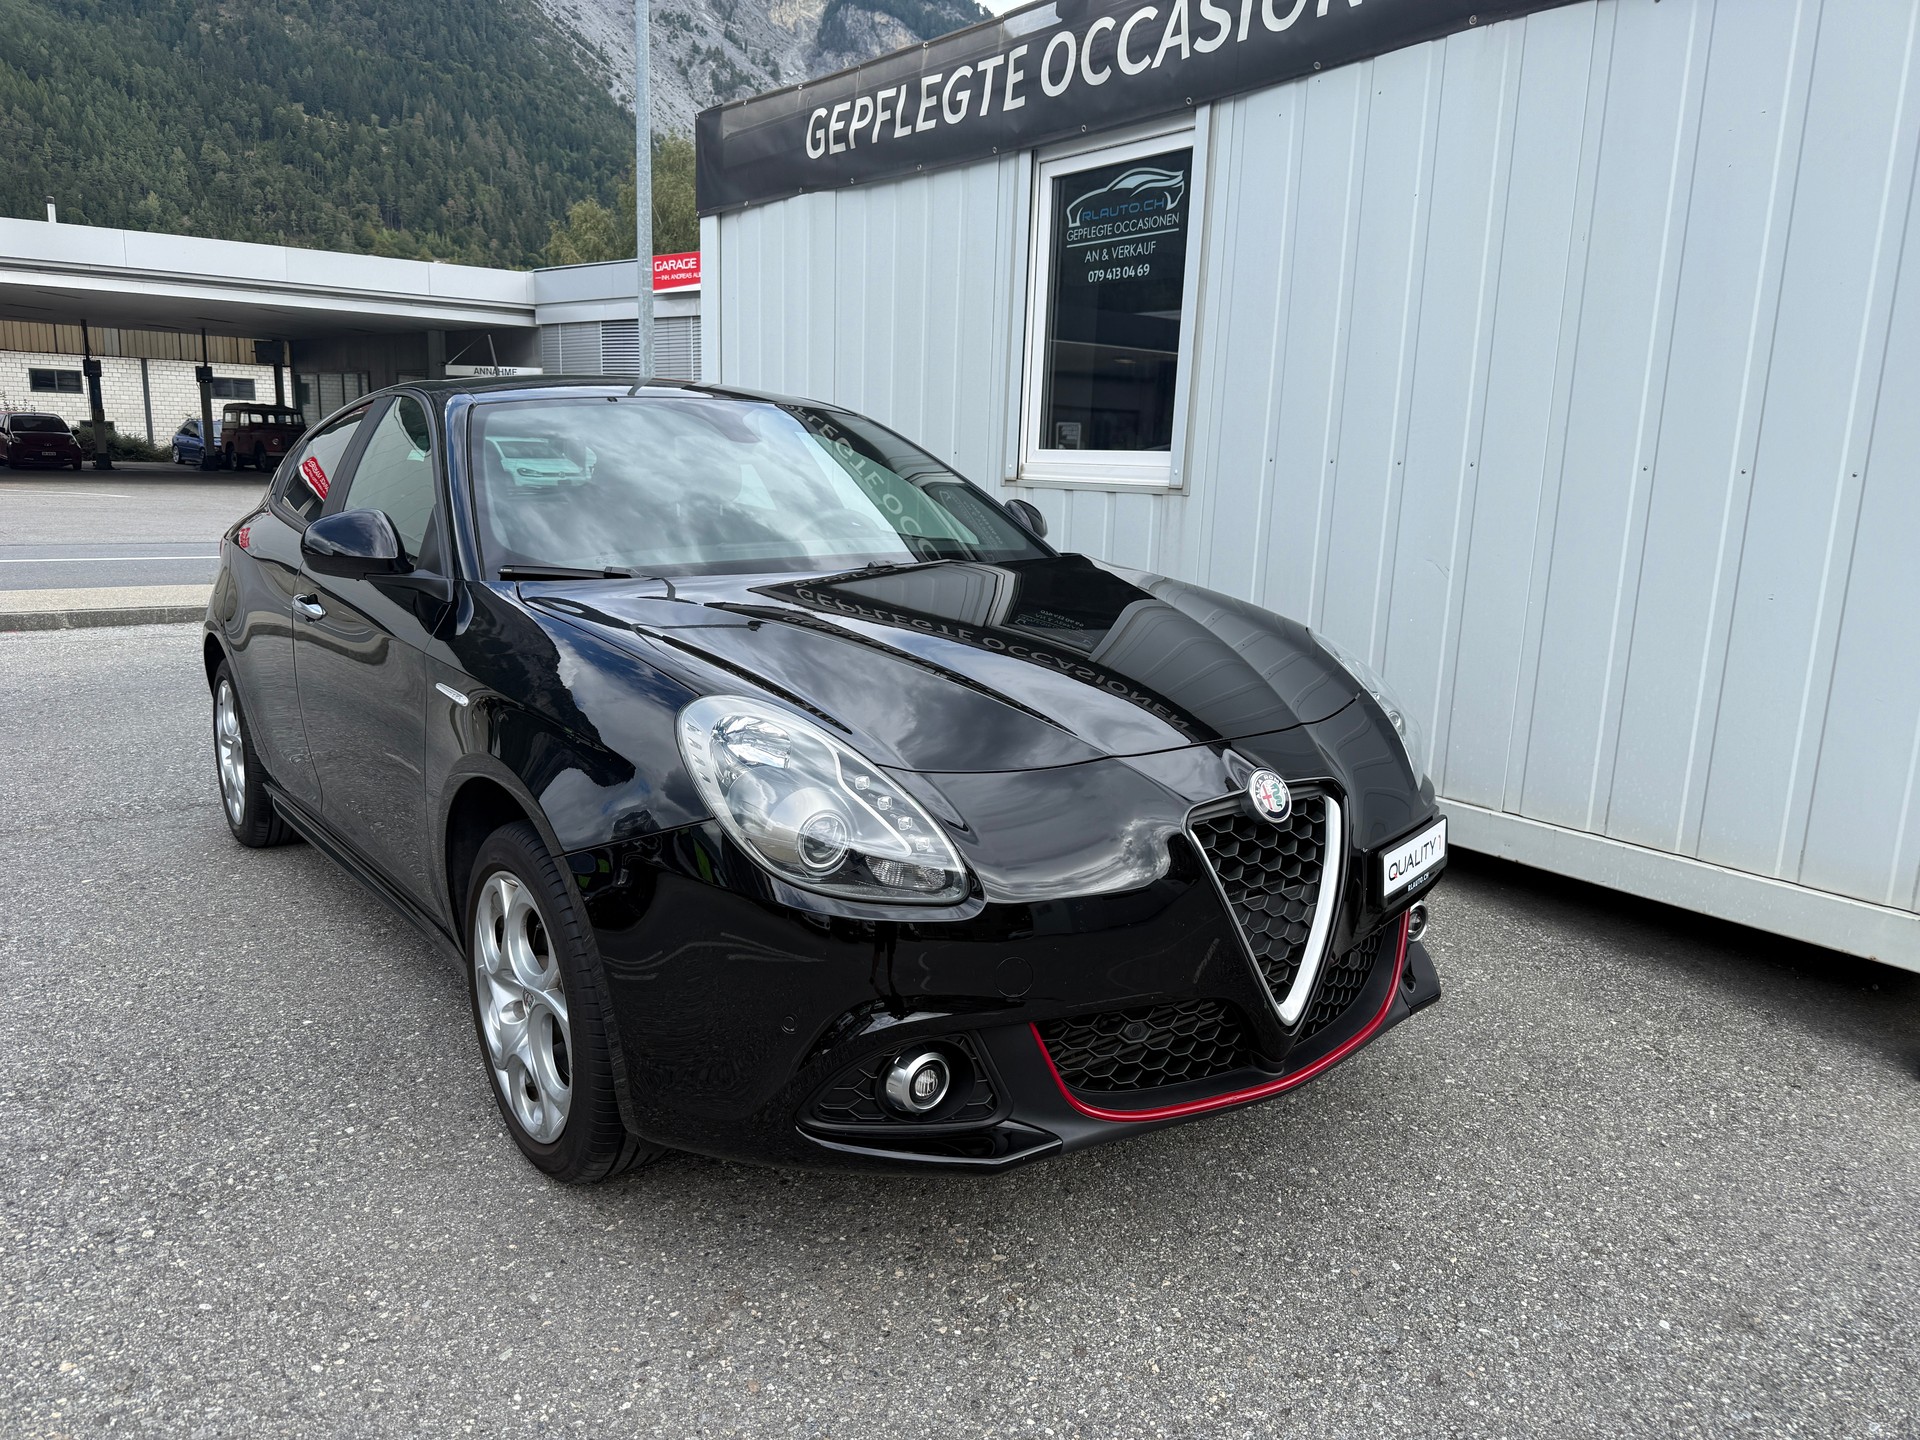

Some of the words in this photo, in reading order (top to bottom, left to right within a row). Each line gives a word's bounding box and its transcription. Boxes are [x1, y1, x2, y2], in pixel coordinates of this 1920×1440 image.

[805, 45, 1026, 160] GEPFLEGTE
[1040, 0, 1363, 98] OCCASI
[1082, 198, 1165, 222] RLAUTO.CH
[1066, 223, 1113, 241] GEPFLEGTE
[1114, 212, 1180, 233] OCCASIONEN
[1084, 249, 1099, 263] AN
[1101, 248, 1109, 261] &
[1111, 240, 1157, 260] VERKAUF
[654, 257, 697, 272] GARAGE
[1087, 270, 1105, 283] 079
[1106, 267, 1121, 281] 413
[1122, 266, 1135, 279] 04
[1136, 263, 1150, 277] 69
[1388, 836, 1437, 882] QUALITY
